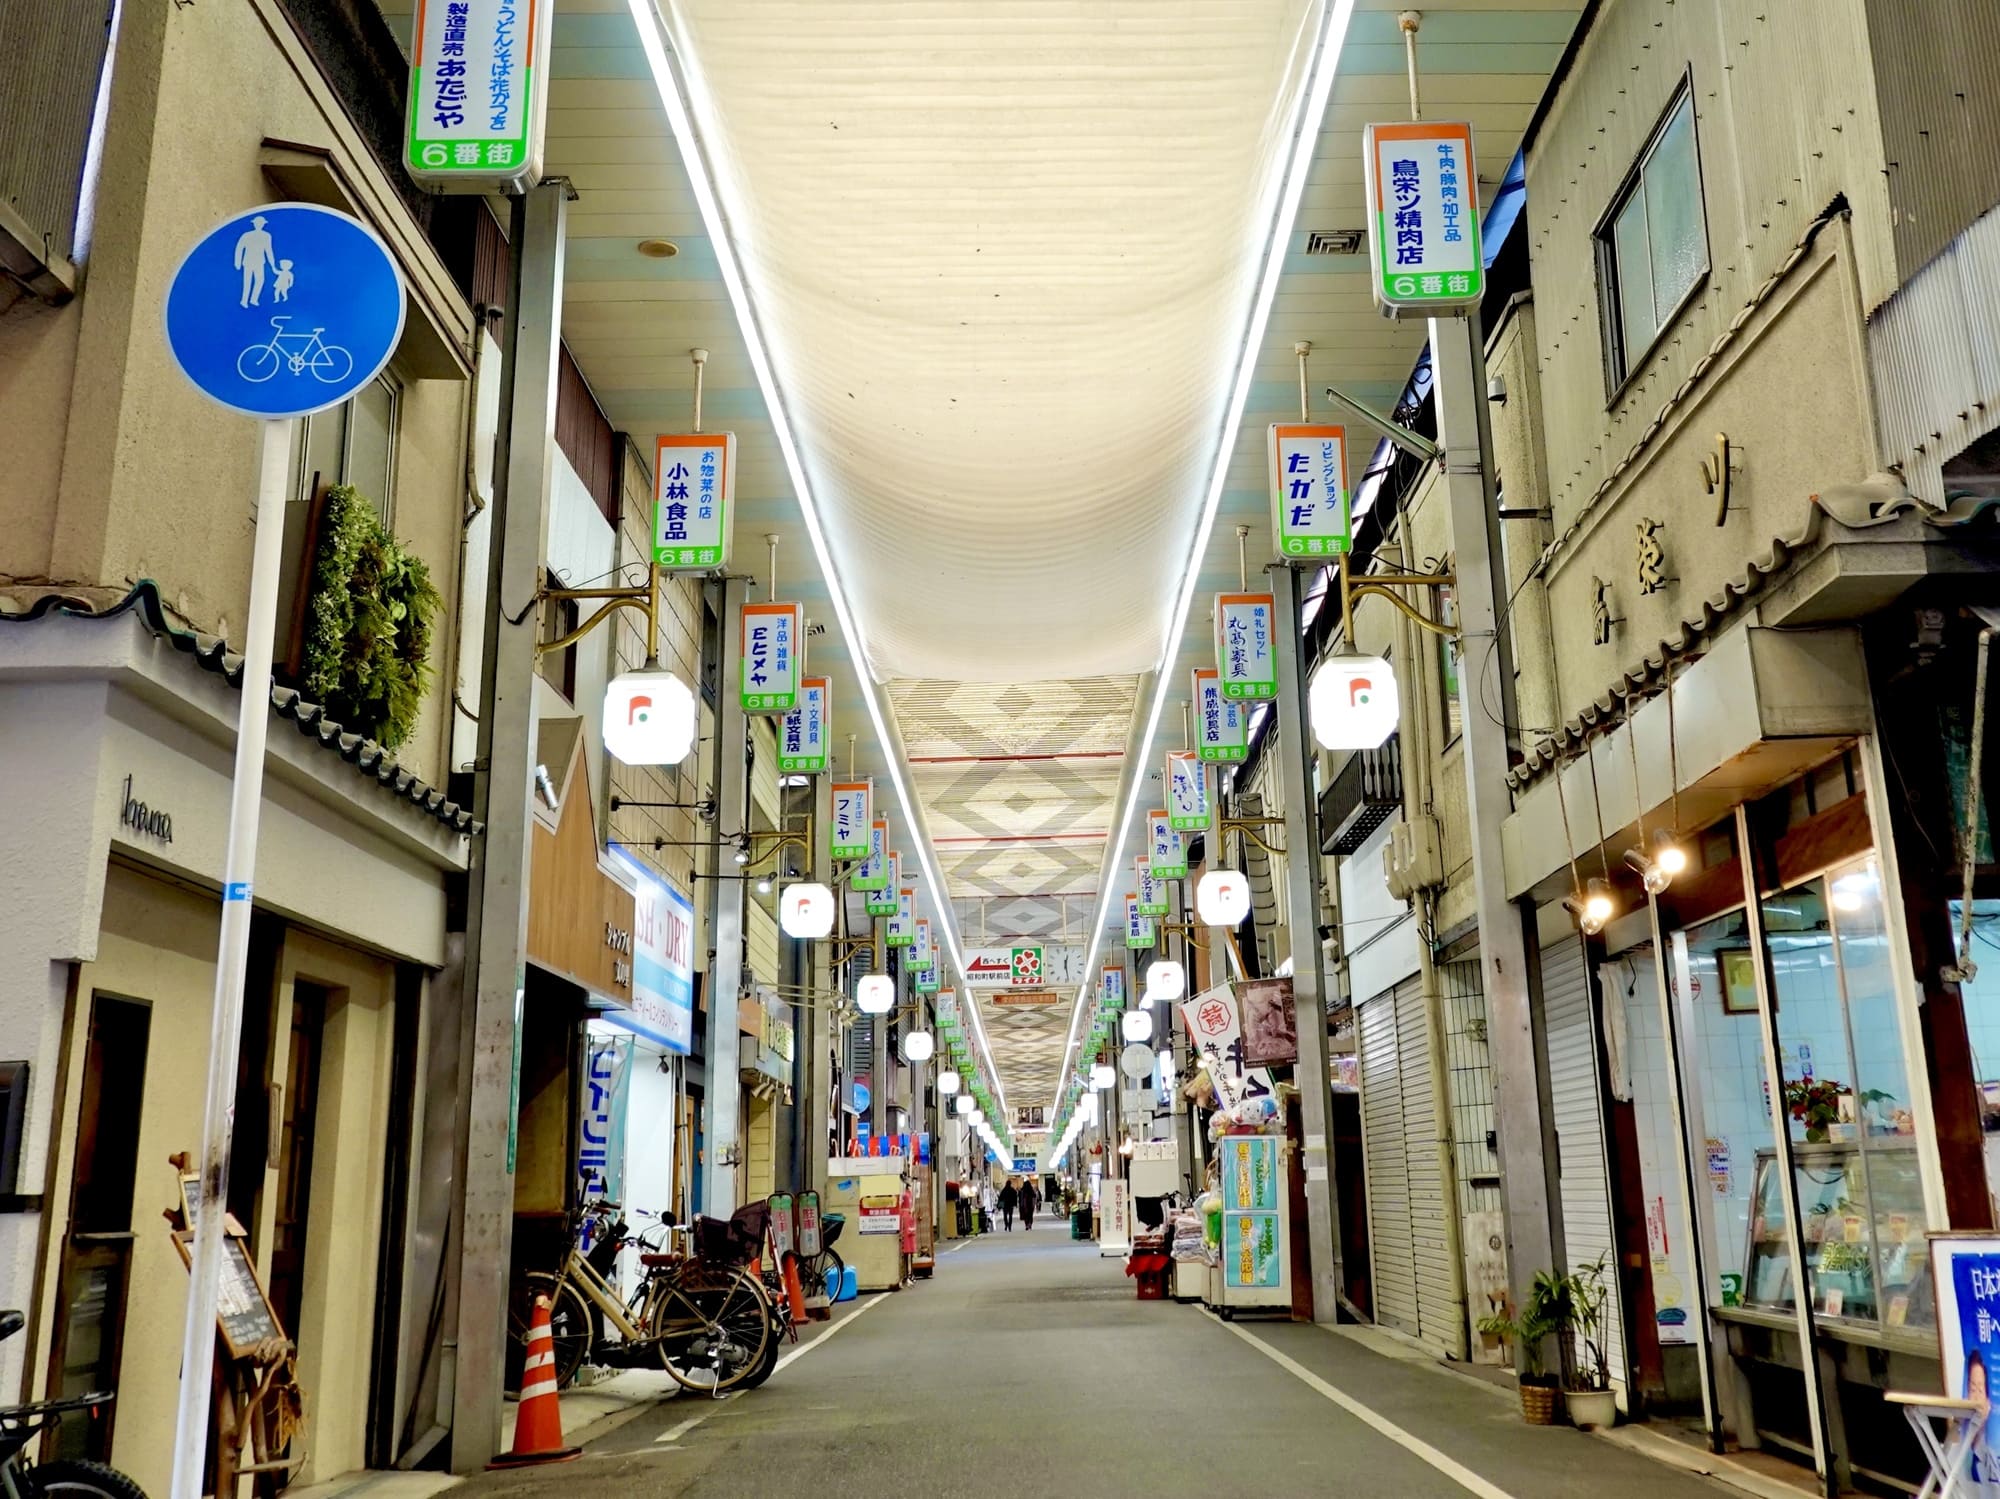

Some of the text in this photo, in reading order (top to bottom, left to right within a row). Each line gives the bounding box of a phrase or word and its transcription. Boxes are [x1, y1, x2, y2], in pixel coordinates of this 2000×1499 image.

[421, 142, 513, 166] 6番街
[1437, 144, 1462, 242] 牛肉・豚肉・加工品
[1392, 159, 1424, 265] 鳥栄ツ精肉店
[1393, 274, 1469, 296] 6番街
[665, 462, 689, 540] 小林食品
[660, 550, 715, 564] 6番街
[1288, 539, 1342, 553] 6番街
[747, 695, 788, 708] 6番街
[1229, 684, 1270, 696] 6番街
[838, 799, 850, 840] フミヤ
